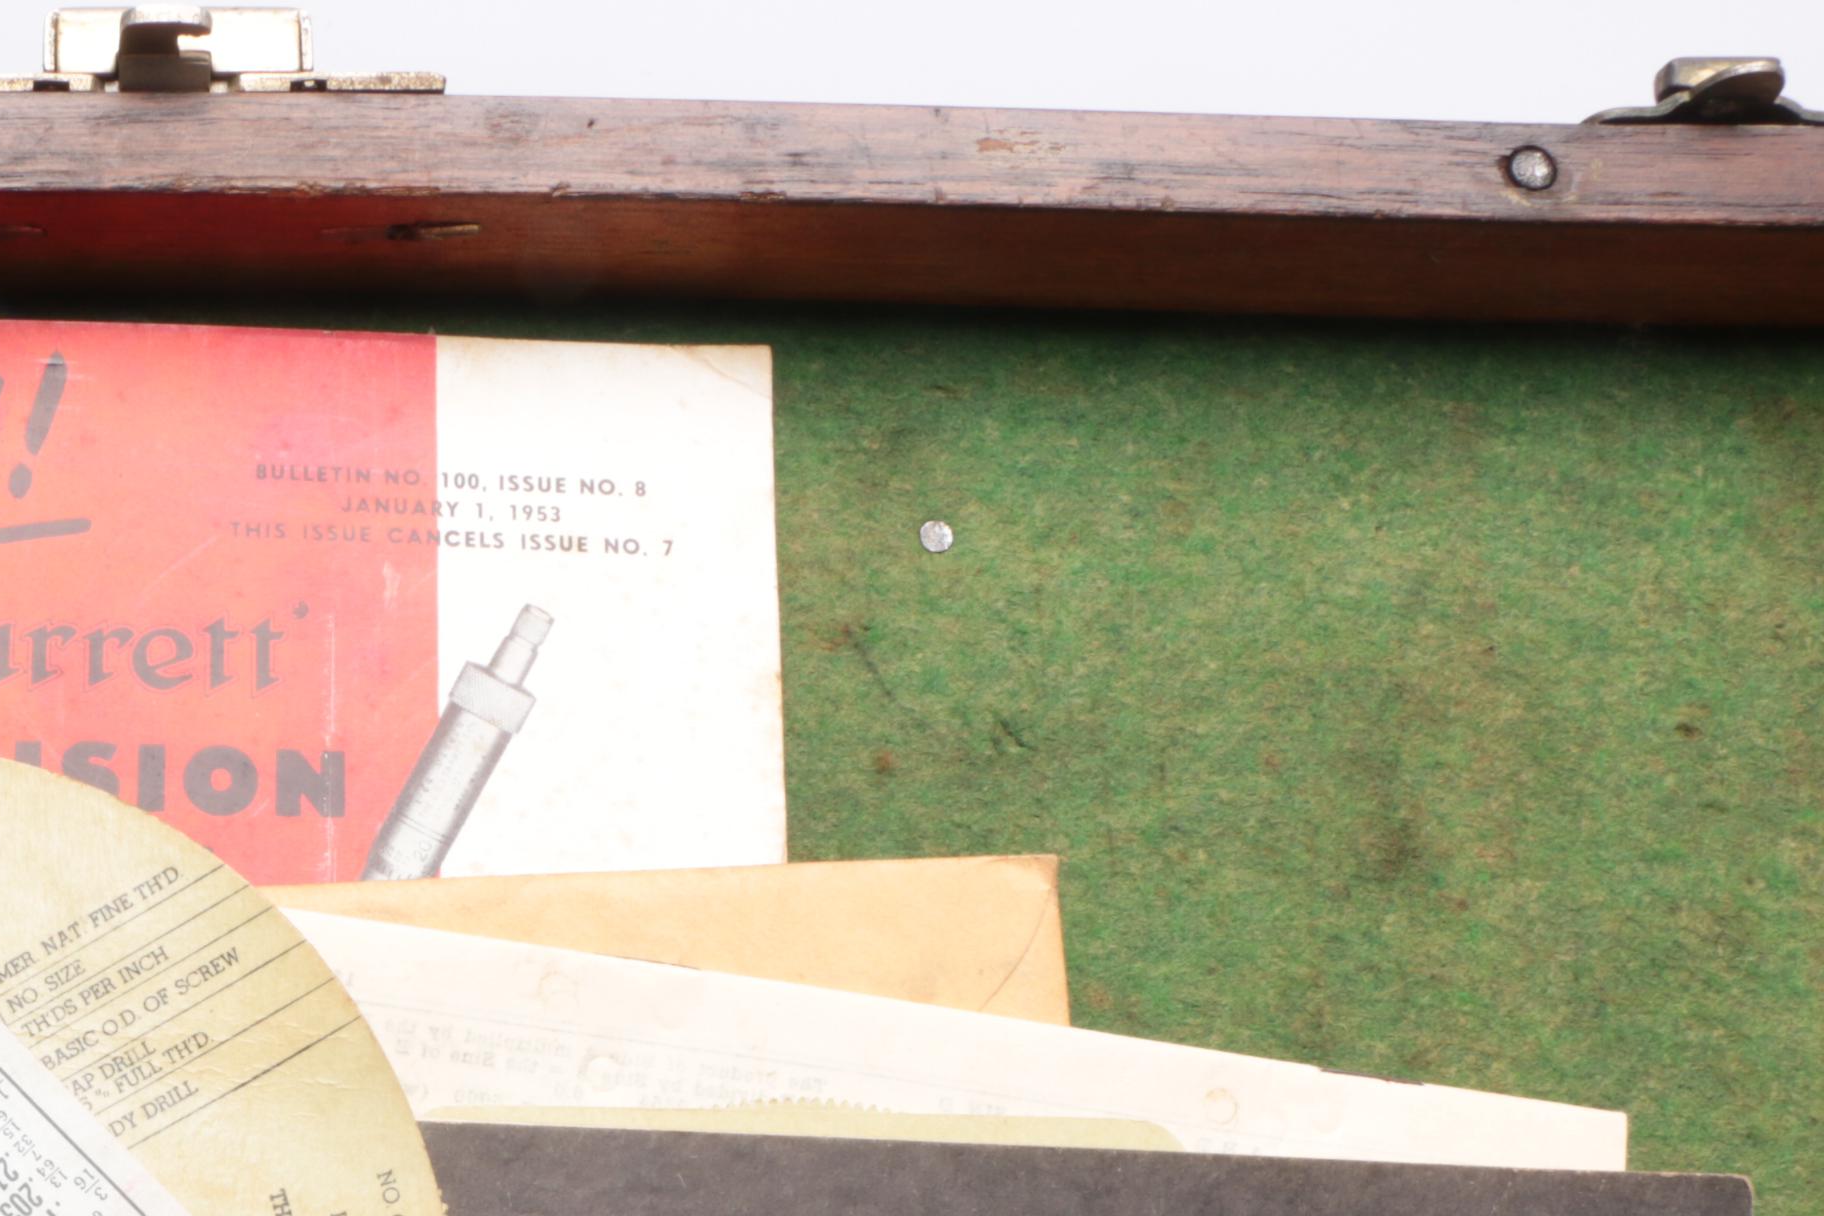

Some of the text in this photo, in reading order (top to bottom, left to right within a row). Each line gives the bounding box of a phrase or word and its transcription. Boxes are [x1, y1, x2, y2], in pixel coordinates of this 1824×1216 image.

[256, 464, 371, 484] BULLETIN
[441, 471, 487, 491] 100,
[499, 474, 566, 494] ISSUE
[580, 477, 622, 497] NO.
[635, 481, 646, 498] 8
[341, 495, 561, 523] JANUARY 1, 1953
[231, 521, 673, 557] THIS ISSUE CANCELS ISSUE NO. 7
[88, 893, 134, 928] FINE
[44, 959, 86, 992] SIZE
[78, 977, 117, 1006] PER
[117, 945, 169, 984] INCH
[40, 946, 239, 1070] BASIC OF SCREW
[98, 1040, 157, 1080] DRILL
[114, 1059, 164, 1094] FULL
